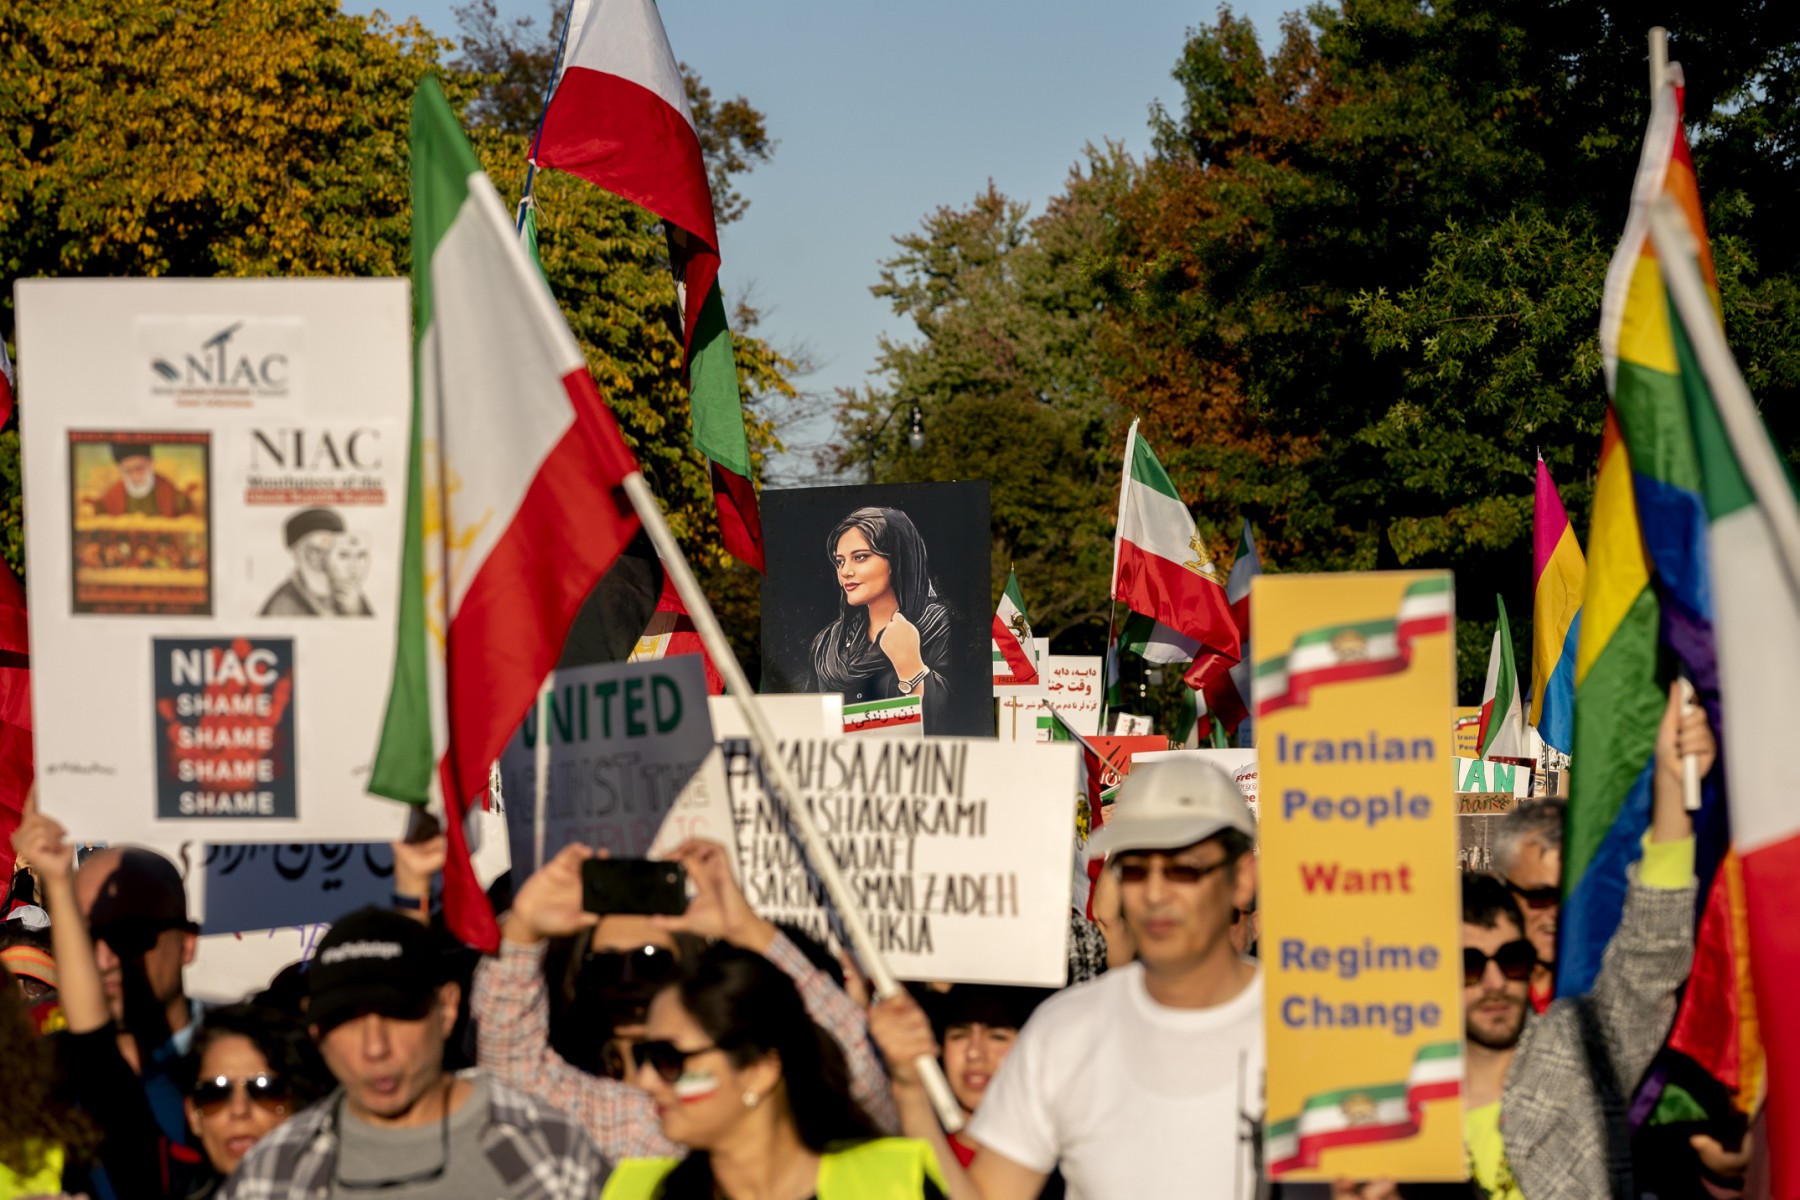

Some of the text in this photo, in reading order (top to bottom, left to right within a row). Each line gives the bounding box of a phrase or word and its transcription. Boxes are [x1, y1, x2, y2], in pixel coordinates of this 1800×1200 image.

[249, 427, 383, 470] NIAC
[170, 648, 279, 686] NIAC
[176, 692, 272, 717] SHAME
[177, 726, 273, 750] SHAME
[1276, 730, 1435, 765] Iranian
[1457, 733, 1478, 741] Irani
[1458, 743, 1477, 752] Peop
[178, 758, 274, 783] SHAME
[1235, 771, 1258, 783] Free
[179, 791, 275, 815] SHAME
[1283, 789, 1431, 828] People
[1300, 862, 1413, 895] Want
[1279, 938, 1441, 980] Regime
[1279, 995, 1442, 1036] Change
